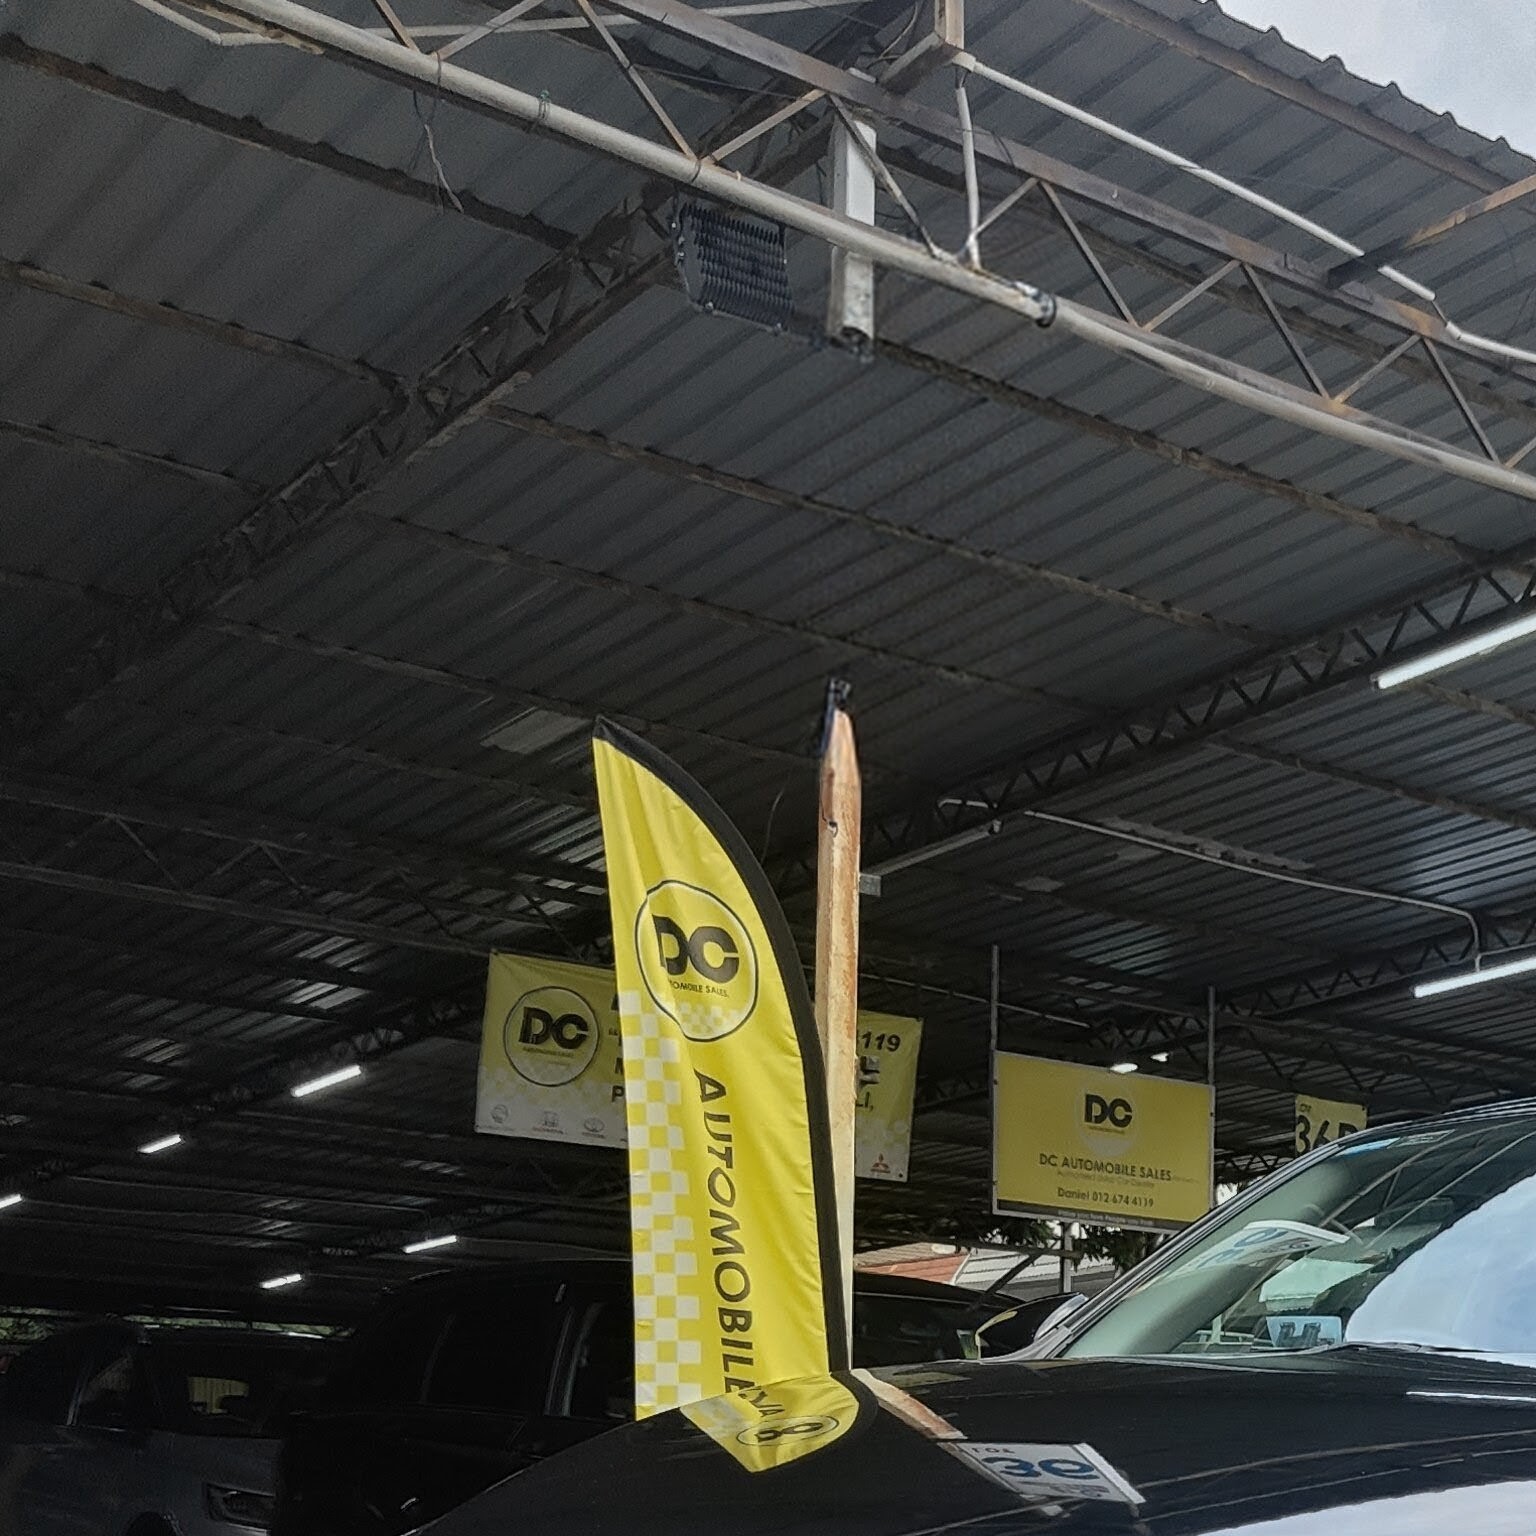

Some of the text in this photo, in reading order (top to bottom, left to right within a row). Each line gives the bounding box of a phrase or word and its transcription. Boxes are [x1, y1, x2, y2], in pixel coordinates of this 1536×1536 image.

[652, 914, 740, 984] DC
[669, 979, 703, 993] OMOBILE
[519, 1006, 589, 1049] DC
[1084, 1093, 1133, 1128] DC
[1039, 1153, 1058, 1167] DC
[1062, 1157, 1136, 1177] AUTOMOBILE
[1139, 1166, 1171, 1181] SALES
[1057, 1187, 1089, 1200] Daniel
